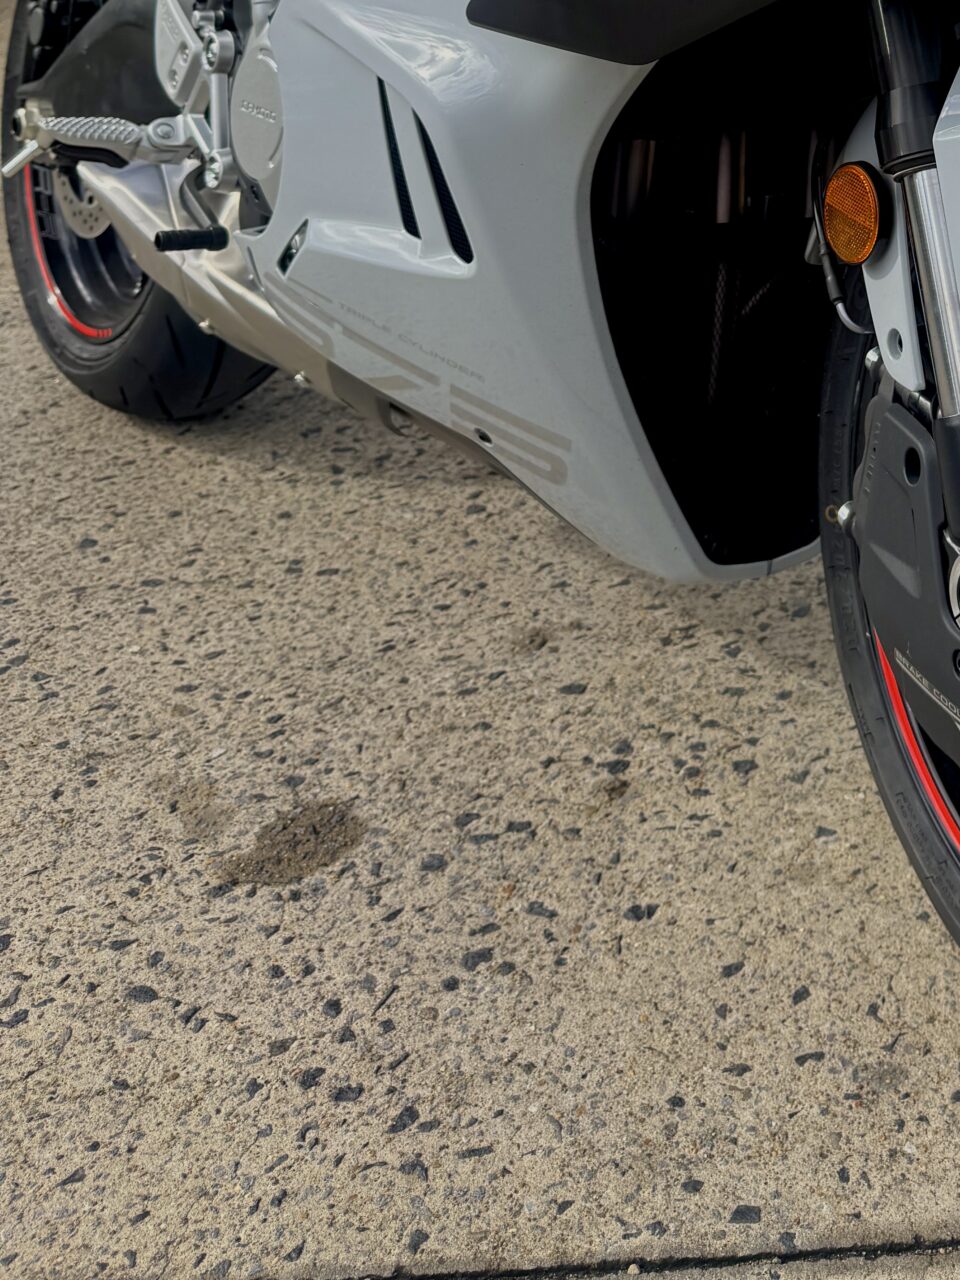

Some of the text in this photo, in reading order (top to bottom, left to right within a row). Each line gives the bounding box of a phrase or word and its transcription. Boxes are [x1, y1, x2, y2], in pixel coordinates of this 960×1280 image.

[339, 302, 487, 384] TRIPLE CYLINDER
[894, 647, 929, 689] BRAKE
